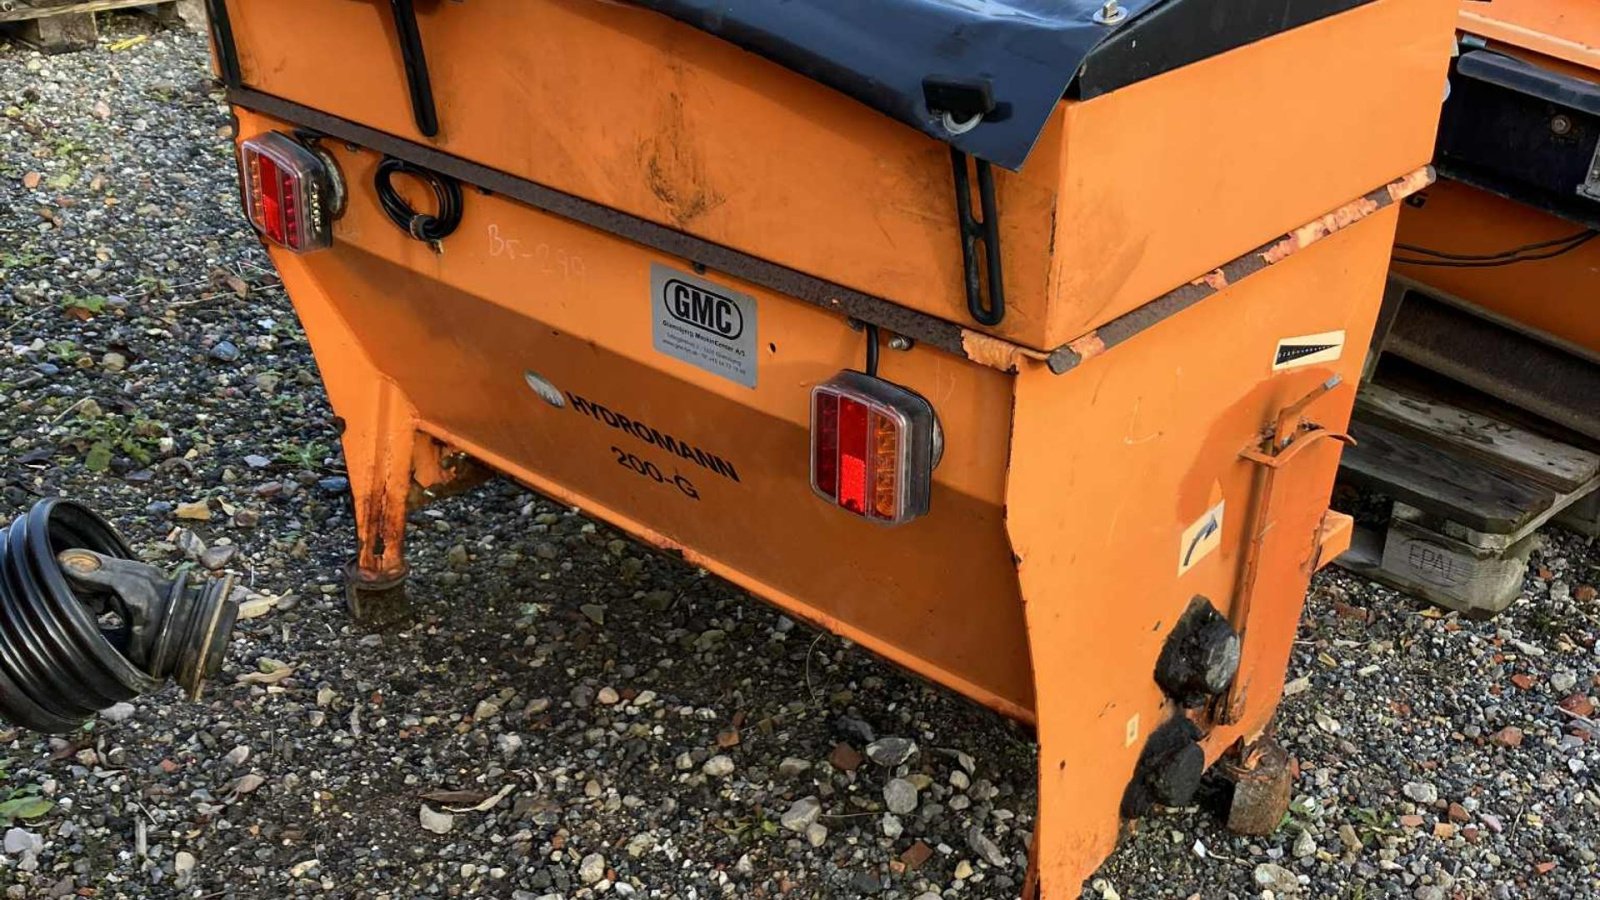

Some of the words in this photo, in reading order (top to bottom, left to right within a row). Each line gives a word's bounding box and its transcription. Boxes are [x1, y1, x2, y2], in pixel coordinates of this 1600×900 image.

[674, 284, 732, 334] GMC
[565, 390, 741, 482] HYDROMANN
[611, 446, 700, 500] 200-G
